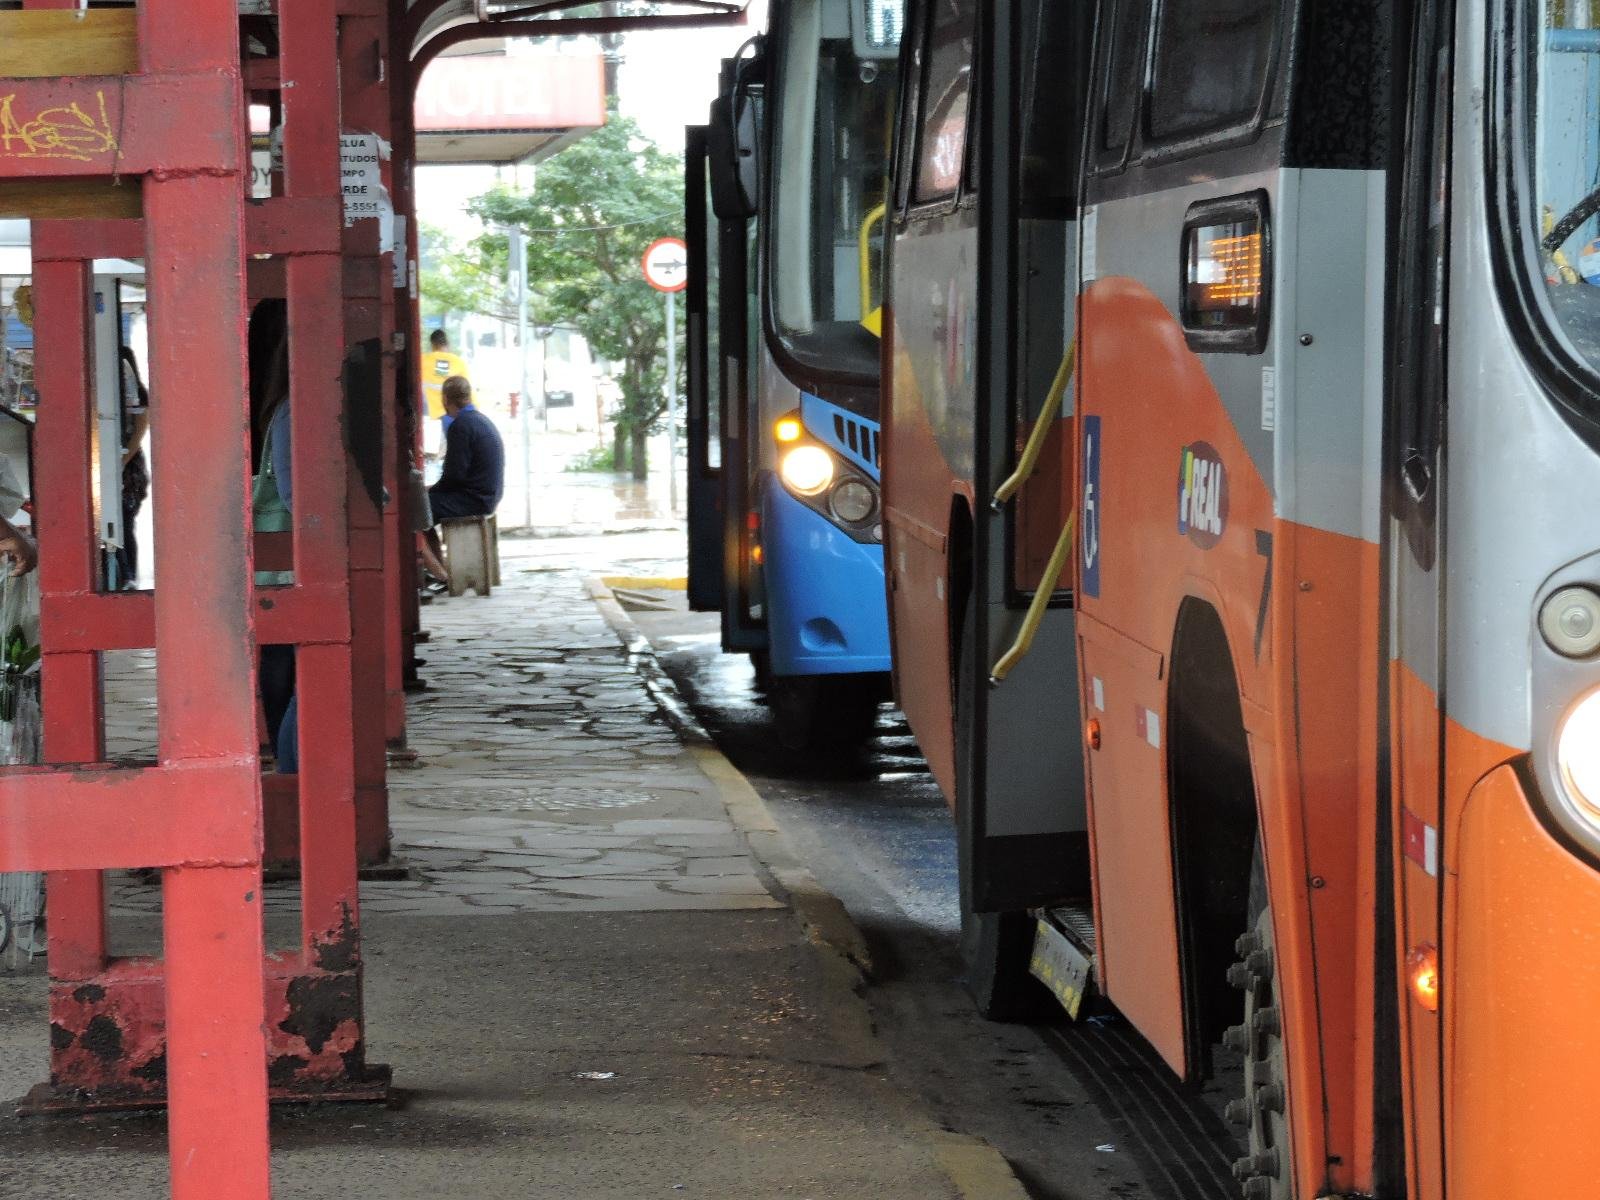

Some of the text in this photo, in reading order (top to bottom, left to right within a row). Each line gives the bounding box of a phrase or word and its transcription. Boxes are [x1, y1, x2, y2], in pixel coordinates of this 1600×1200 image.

[339, 155, 377, 163] TUDOS
[340, 169, 366, 177] MPO
[340, 185, 368, 194] RDE
[1190, 458, 1221, 535] REAL
